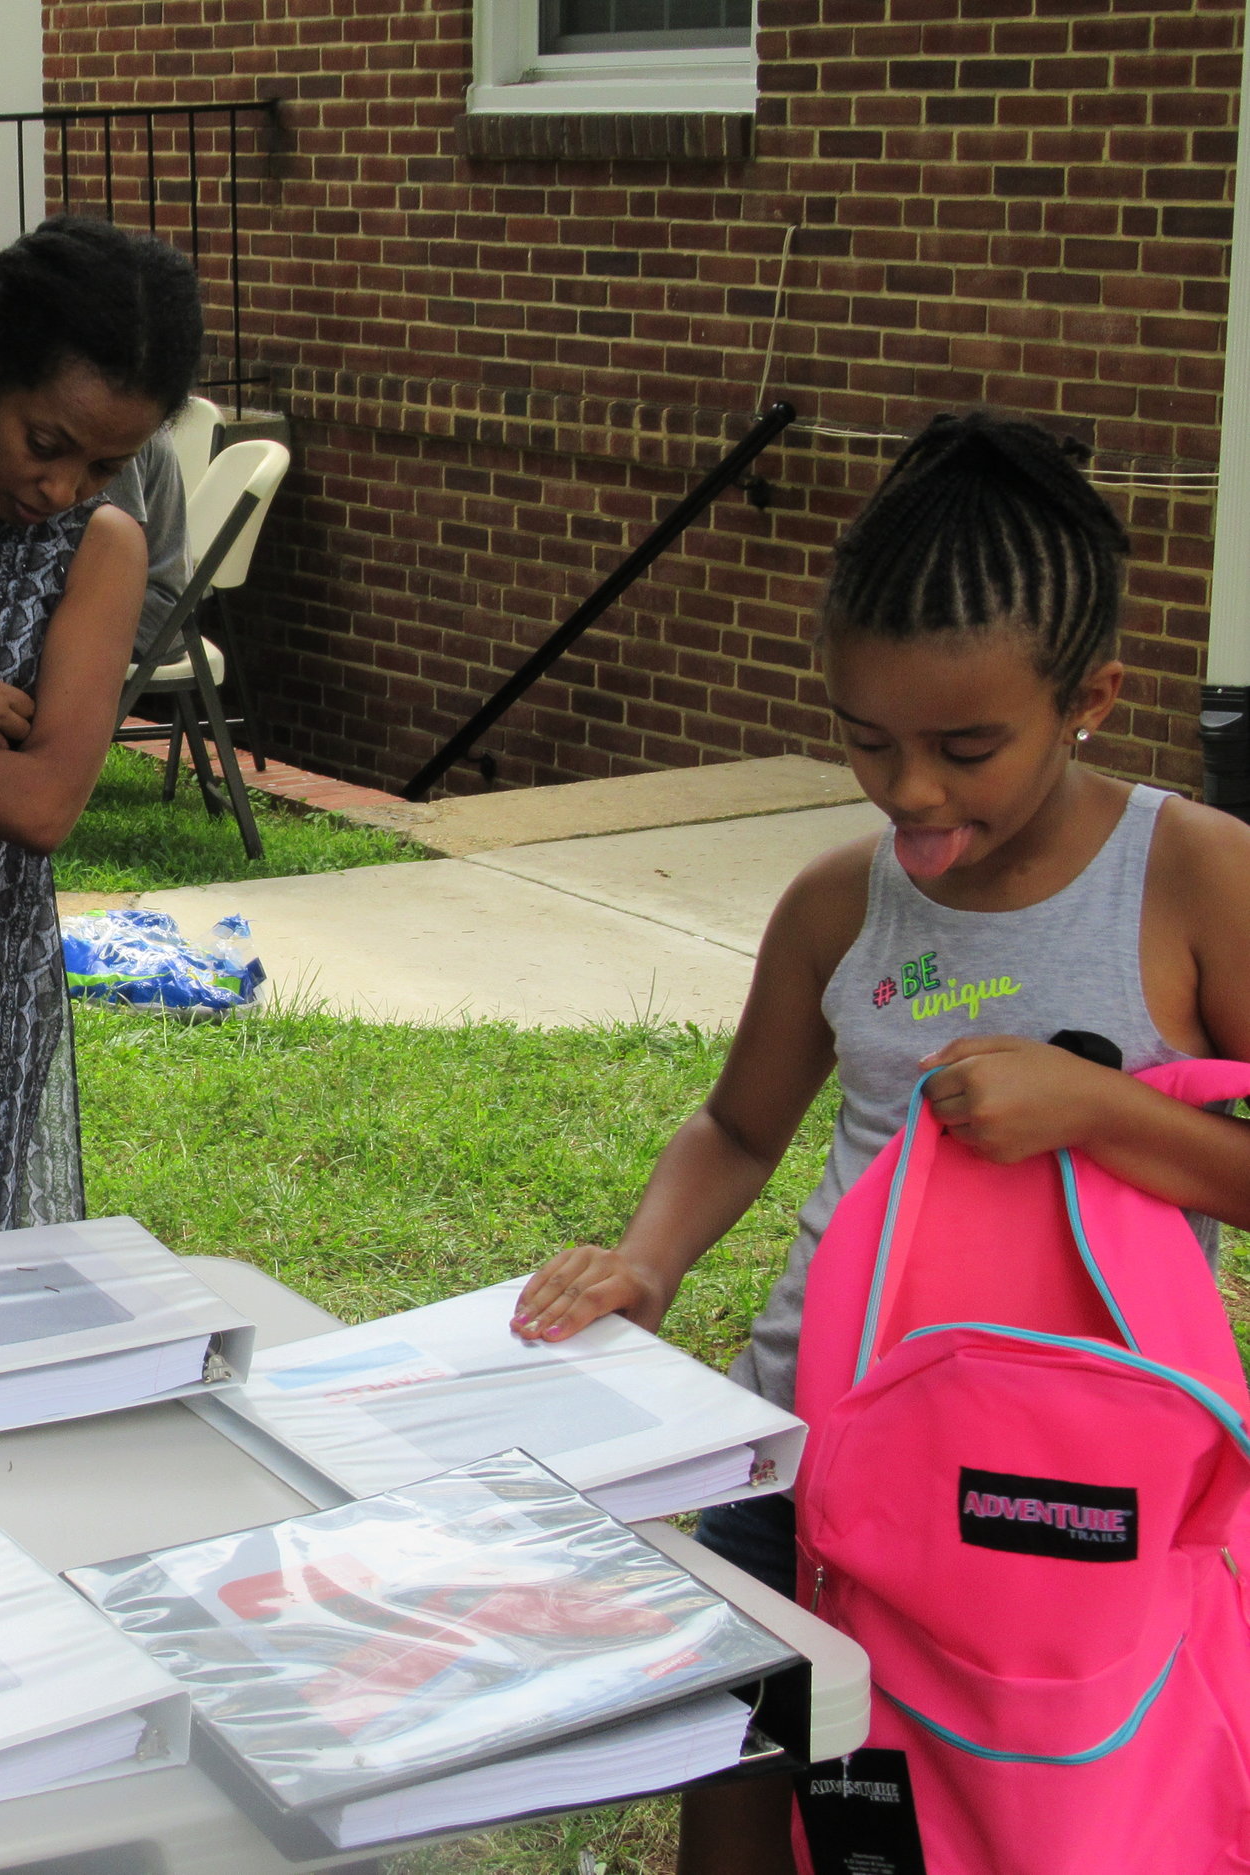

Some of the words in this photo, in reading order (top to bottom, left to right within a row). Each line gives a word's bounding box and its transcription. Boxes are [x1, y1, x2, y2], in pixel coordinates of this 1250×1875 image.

[911, 976, 1023, 1021] unique
[963, 1491, 1127, 1532] ADVENTURE
[1068, 1529, 1127, 1543] TRAILS
[810, 1780, 899, 1797] ADVENTURE
